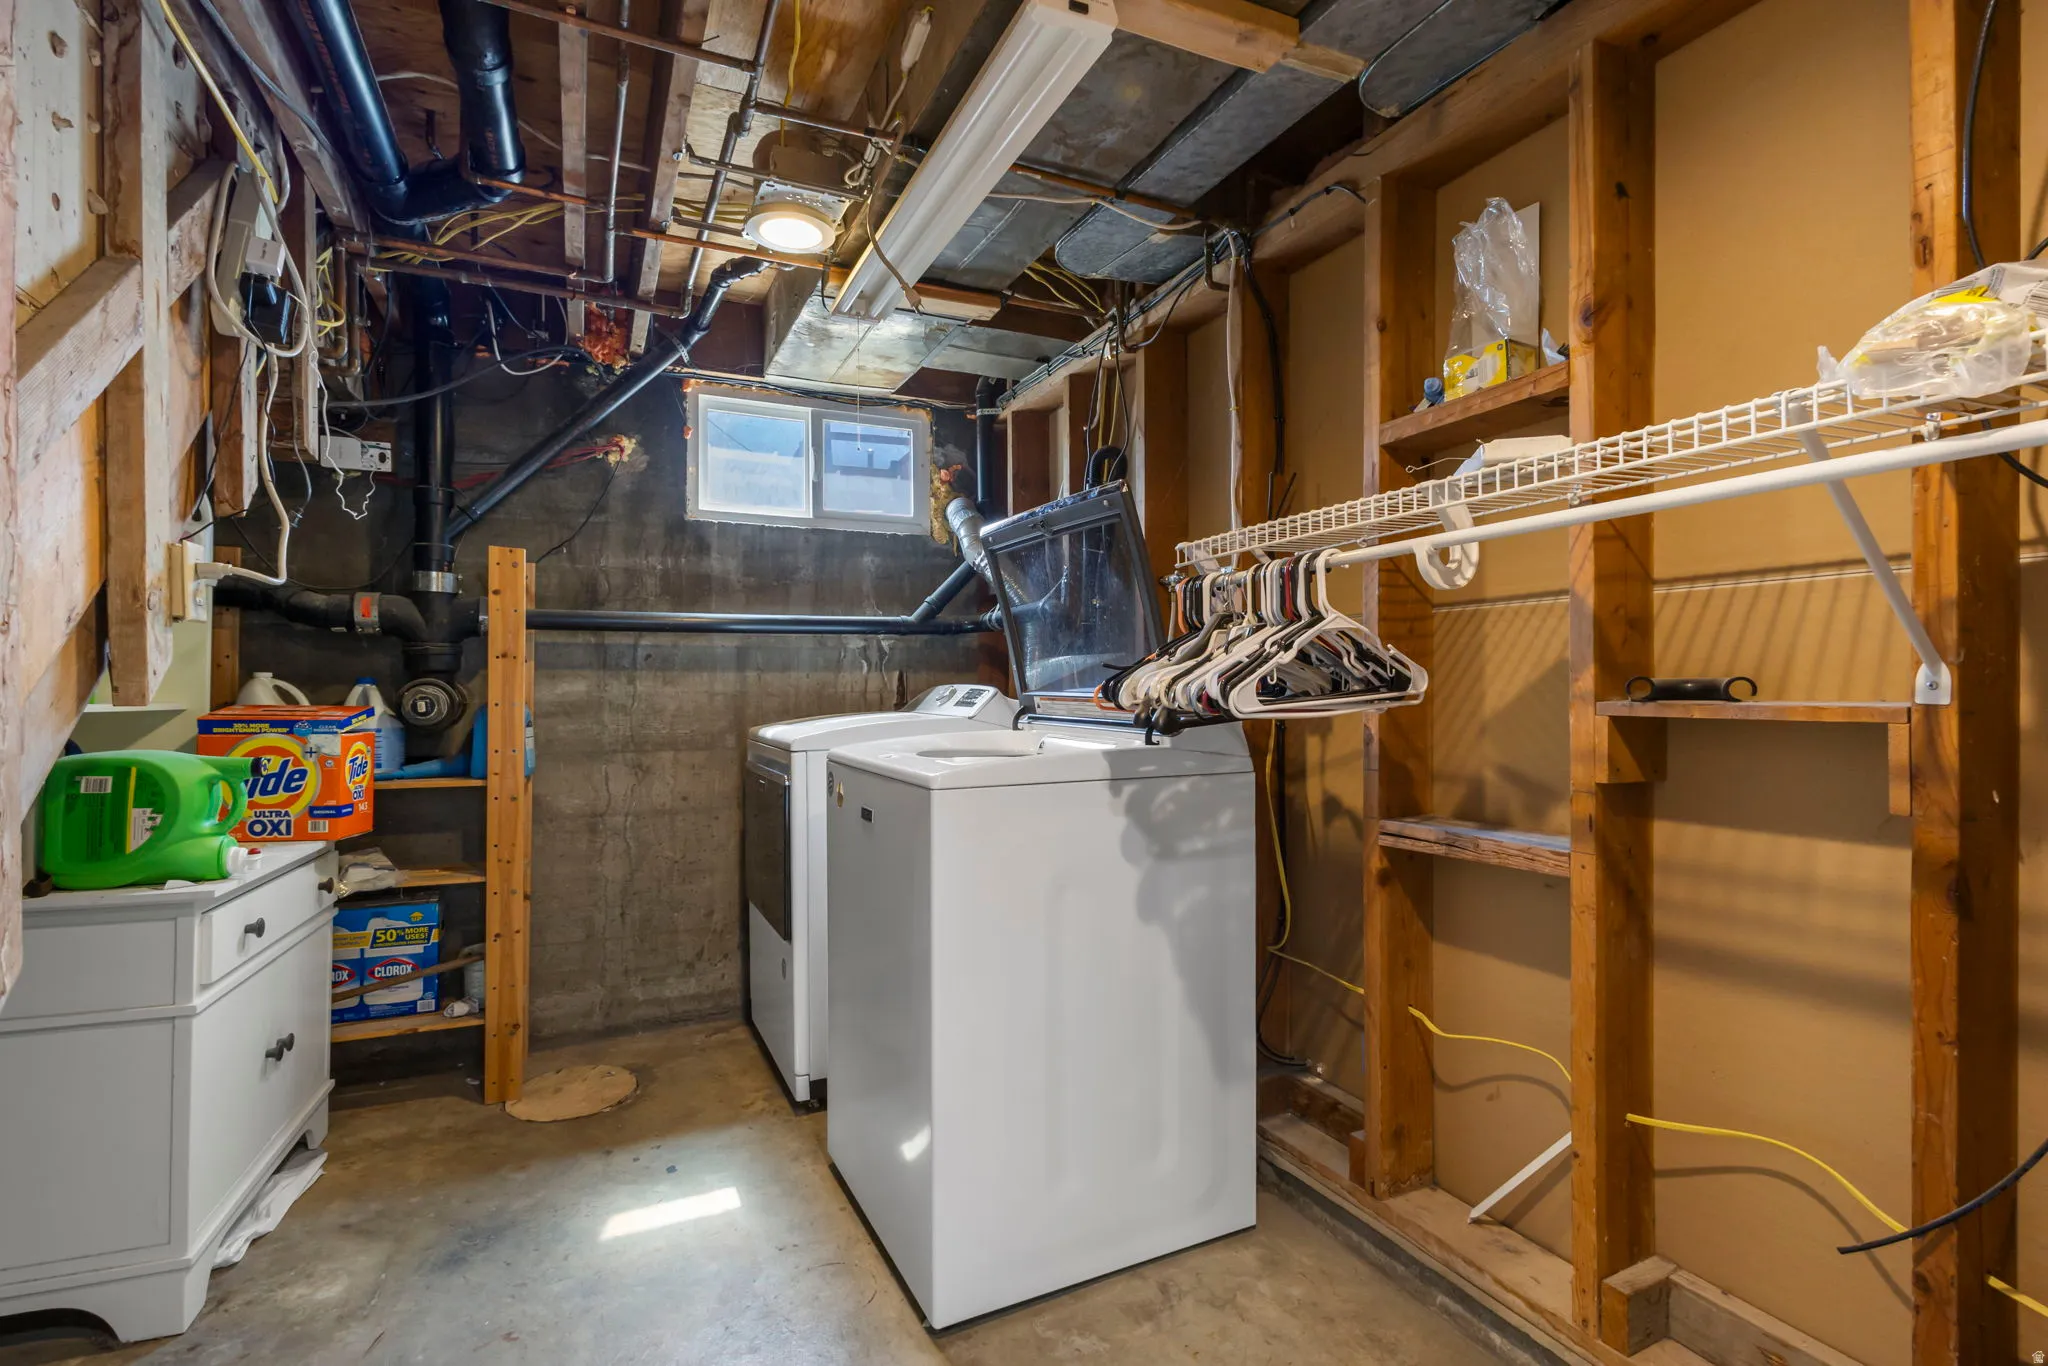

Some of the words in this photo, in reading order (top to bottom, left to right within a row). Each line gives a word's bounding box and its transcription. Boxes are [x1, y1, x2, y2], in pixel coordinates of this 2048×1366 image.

[348, 755, 369, 785] Tide
[352, 789, 364, 801] OXI
[253, 810, 291, 818] ULTRA
[247, 819, 292, 837] OXI
[375, 930, 404, 942] 50%
[374, 965, 412, 977] CLOROX
